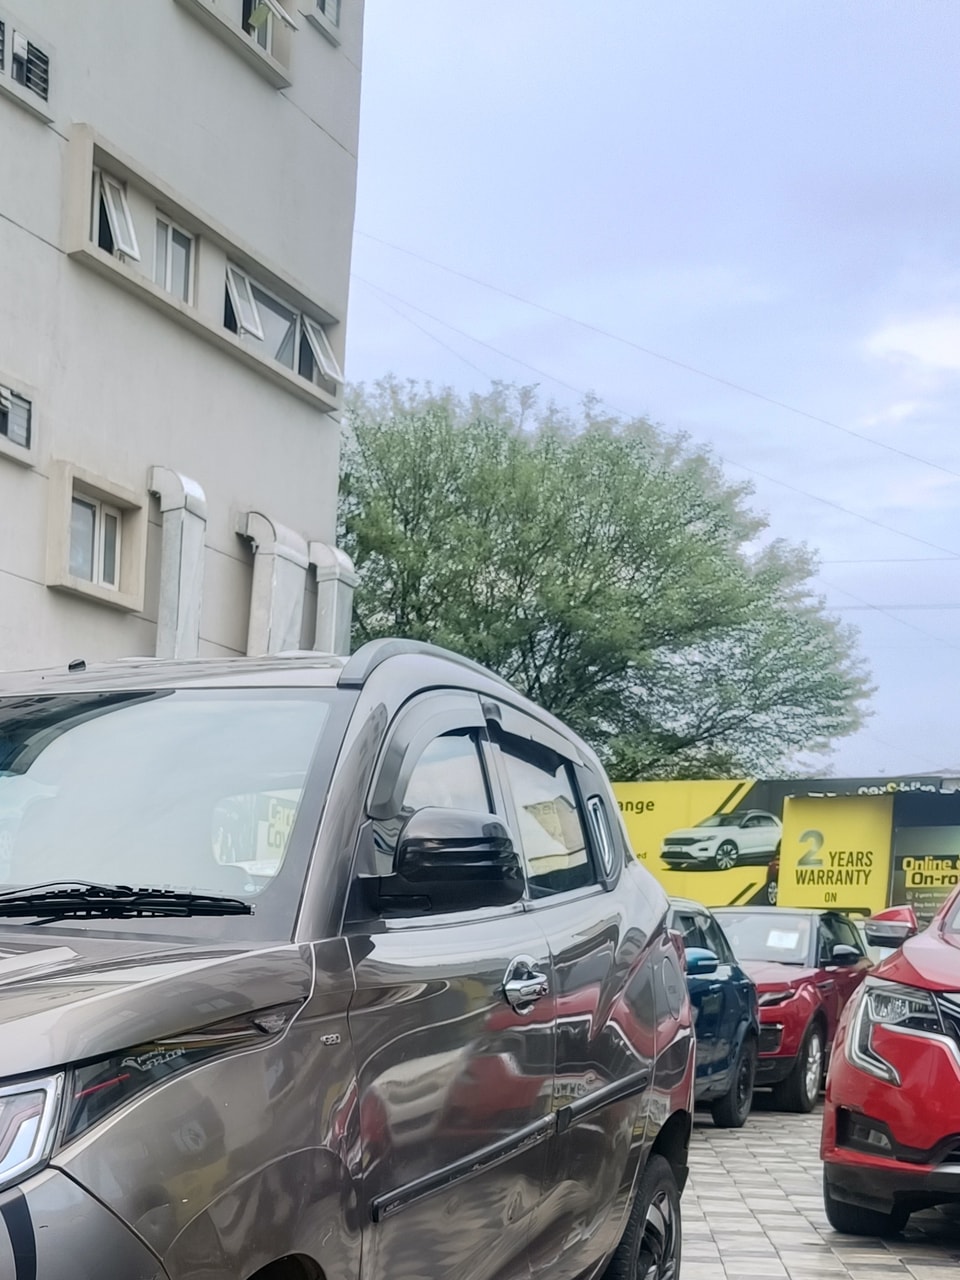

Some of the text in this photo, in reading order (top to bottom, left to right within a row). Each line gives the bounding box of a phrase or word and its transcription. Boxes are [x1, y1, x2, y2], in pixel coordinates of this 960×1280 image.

[797, 829, 873, 867] 2 YEARS
[902, 856, 952, 871] Online
[795, 869, 872, 886] WARRANTY
[911, 872, 958, 885] On-ro
[824, 892, 837, 903] ON
